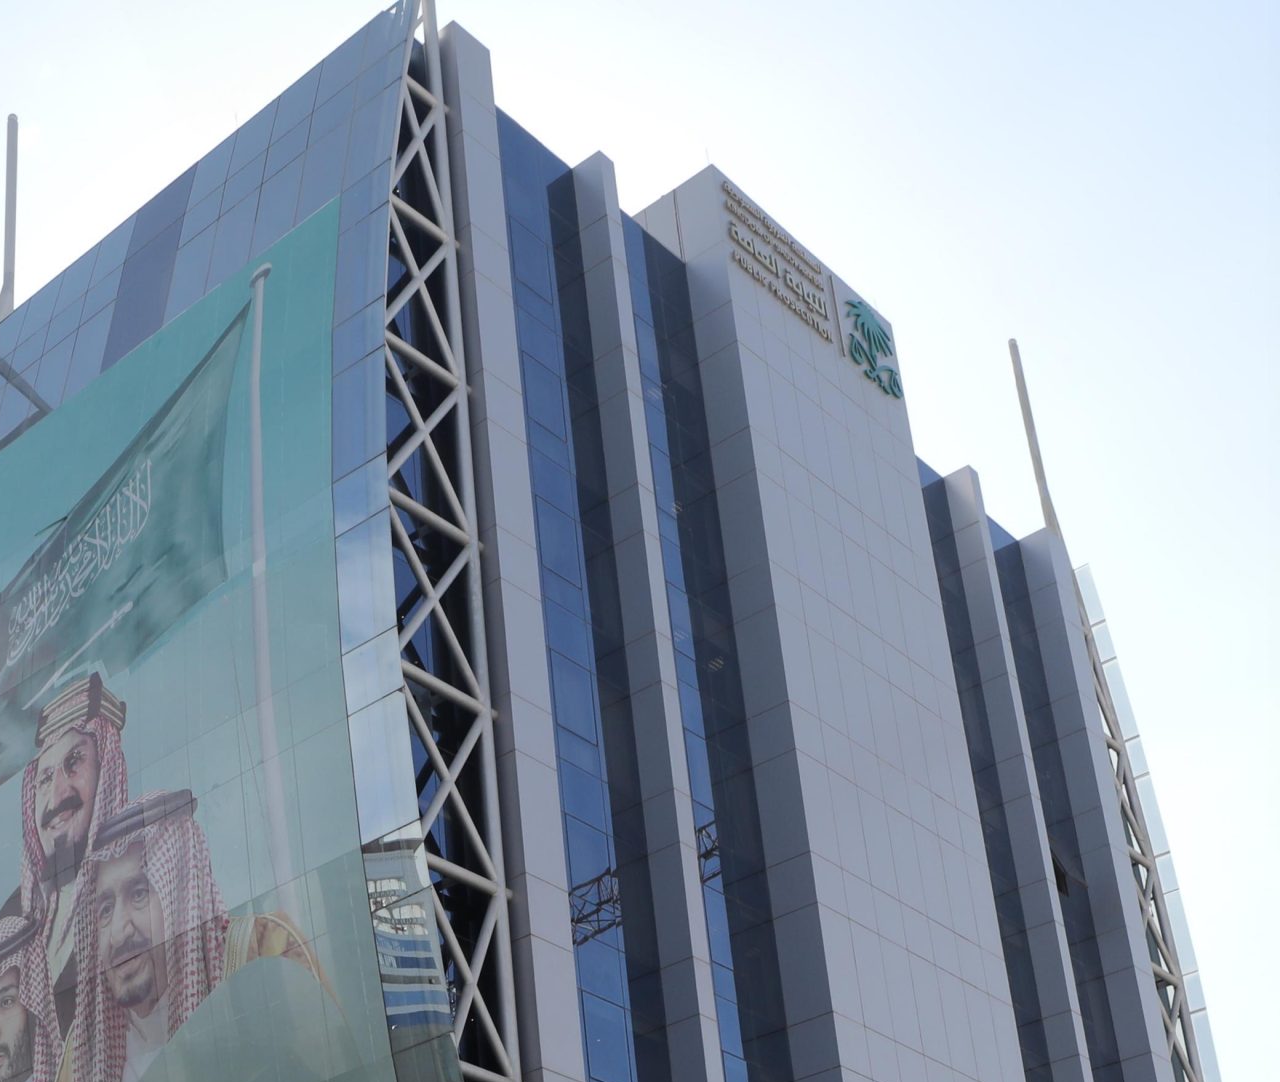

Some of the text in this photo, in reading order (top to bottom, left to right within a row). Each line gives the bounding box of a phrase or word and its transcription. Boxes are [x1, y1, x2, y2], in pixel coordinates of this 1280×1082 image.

[729, 220, 830, 321] النيابة العامة
[732, 250, 768, 288] PUBLIC
